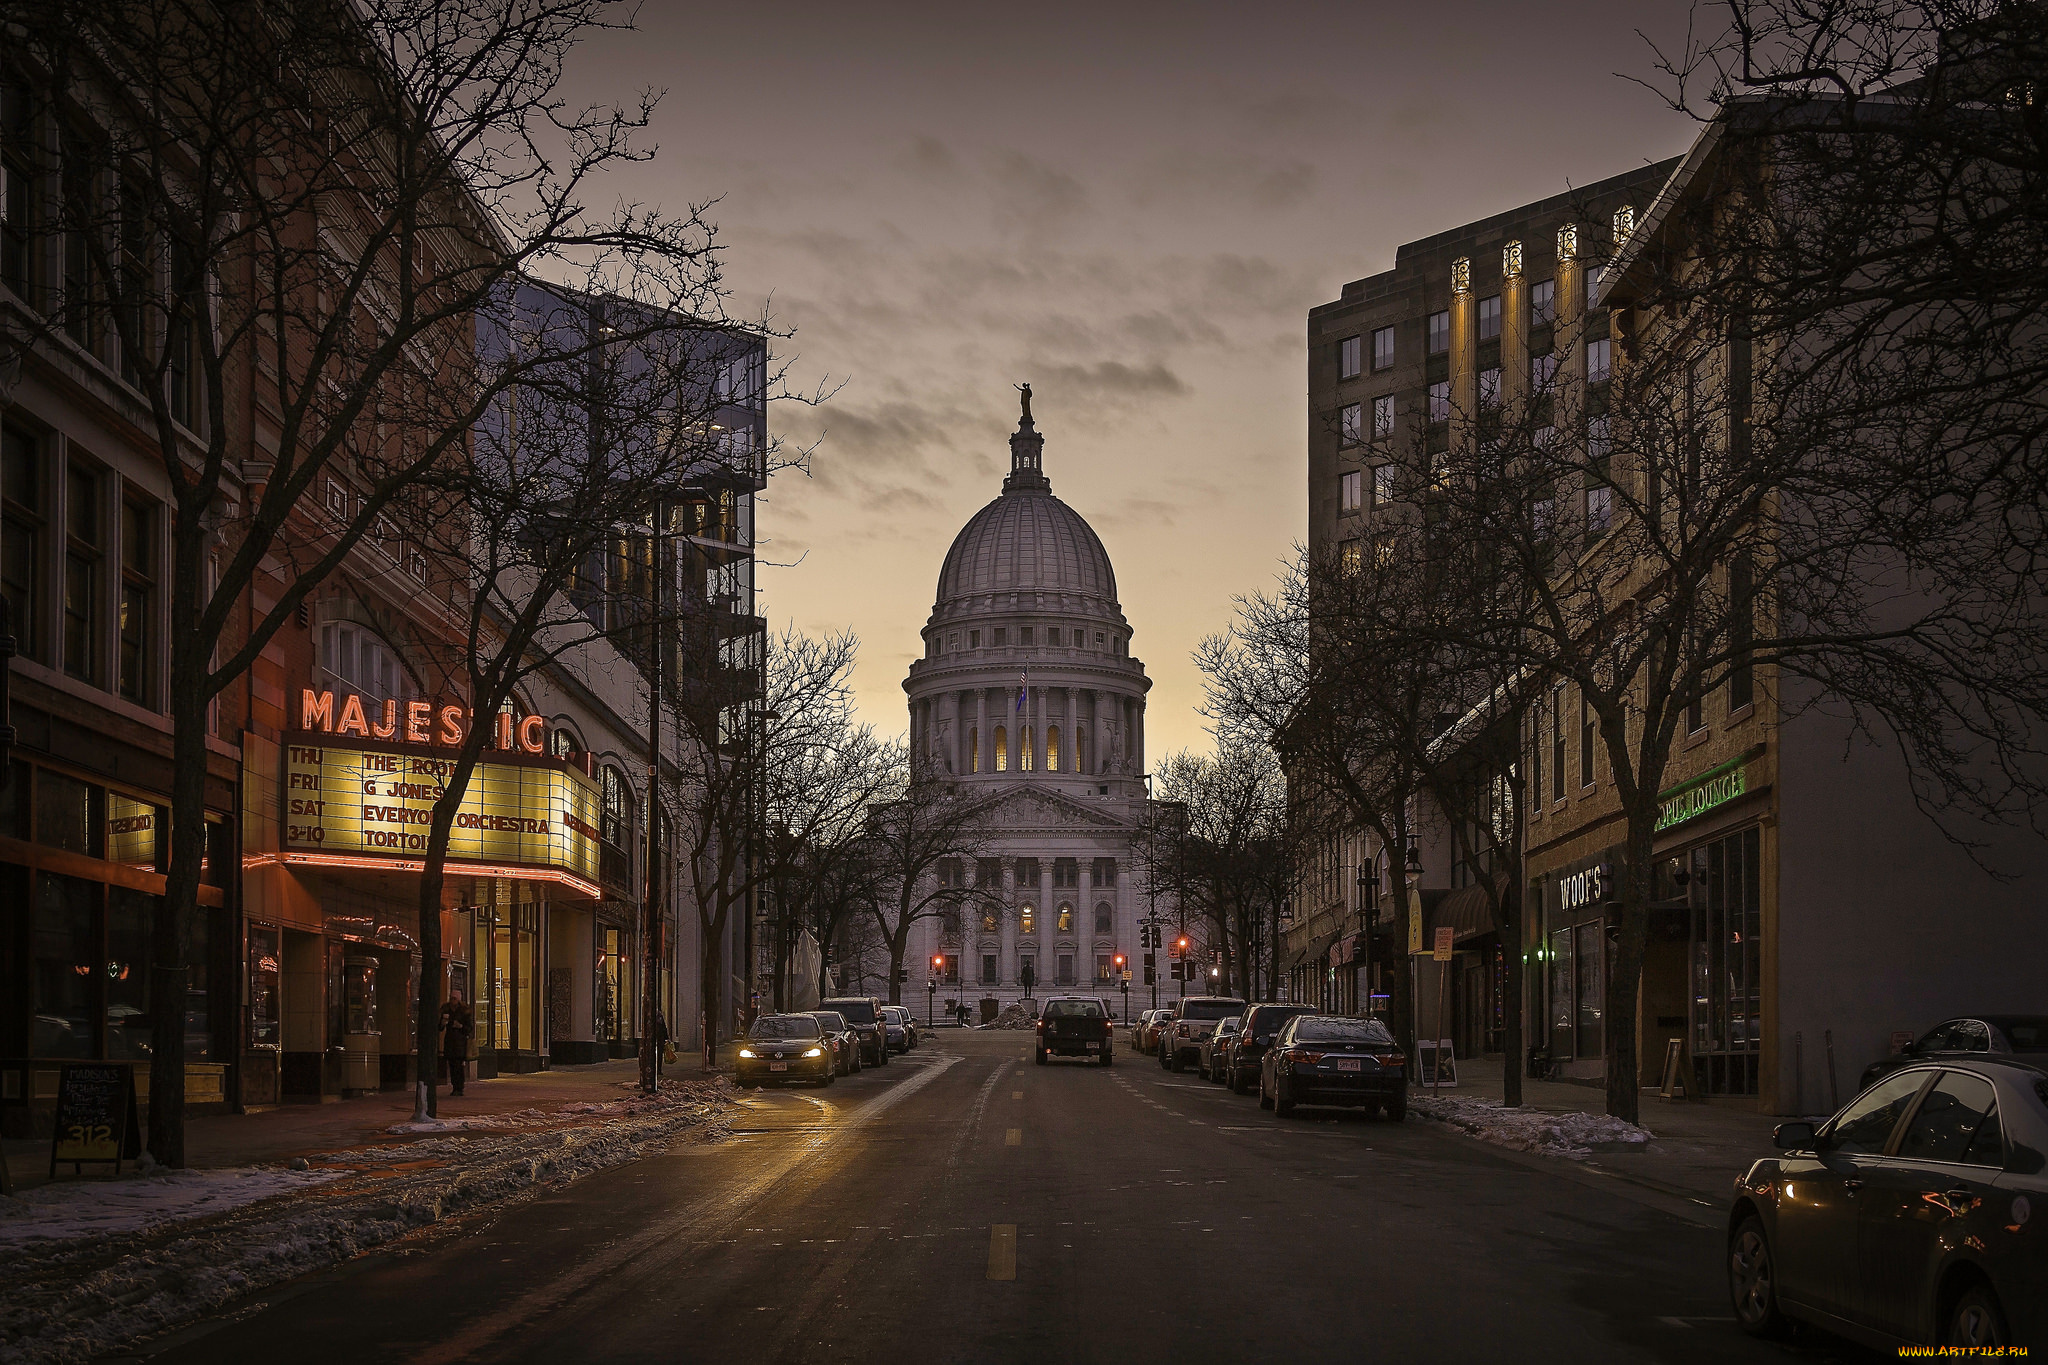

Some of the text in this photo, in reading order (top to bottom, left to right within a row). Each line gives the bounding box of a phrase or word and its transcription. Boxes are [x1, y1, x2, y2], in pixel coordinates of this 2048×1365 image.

[302, 688, 544, 753] MAJESIC
[289, 747, 323, 765] THU
[364, 754, 397, 771] THE
[290, 773, 319, 790] FRI
[364, 780, 444, 800] G JONES
[1691, 773, 1739, 813] LOUNGE
[290, 799, 325, 816] SAT
[363, 805, 434, 825] EVERYO
[456, 813, 550, 834] ORCHESTRA
[364, 830, 450, 852] TORTOI
[1560, 865, 1602, 912] WOOF'S
